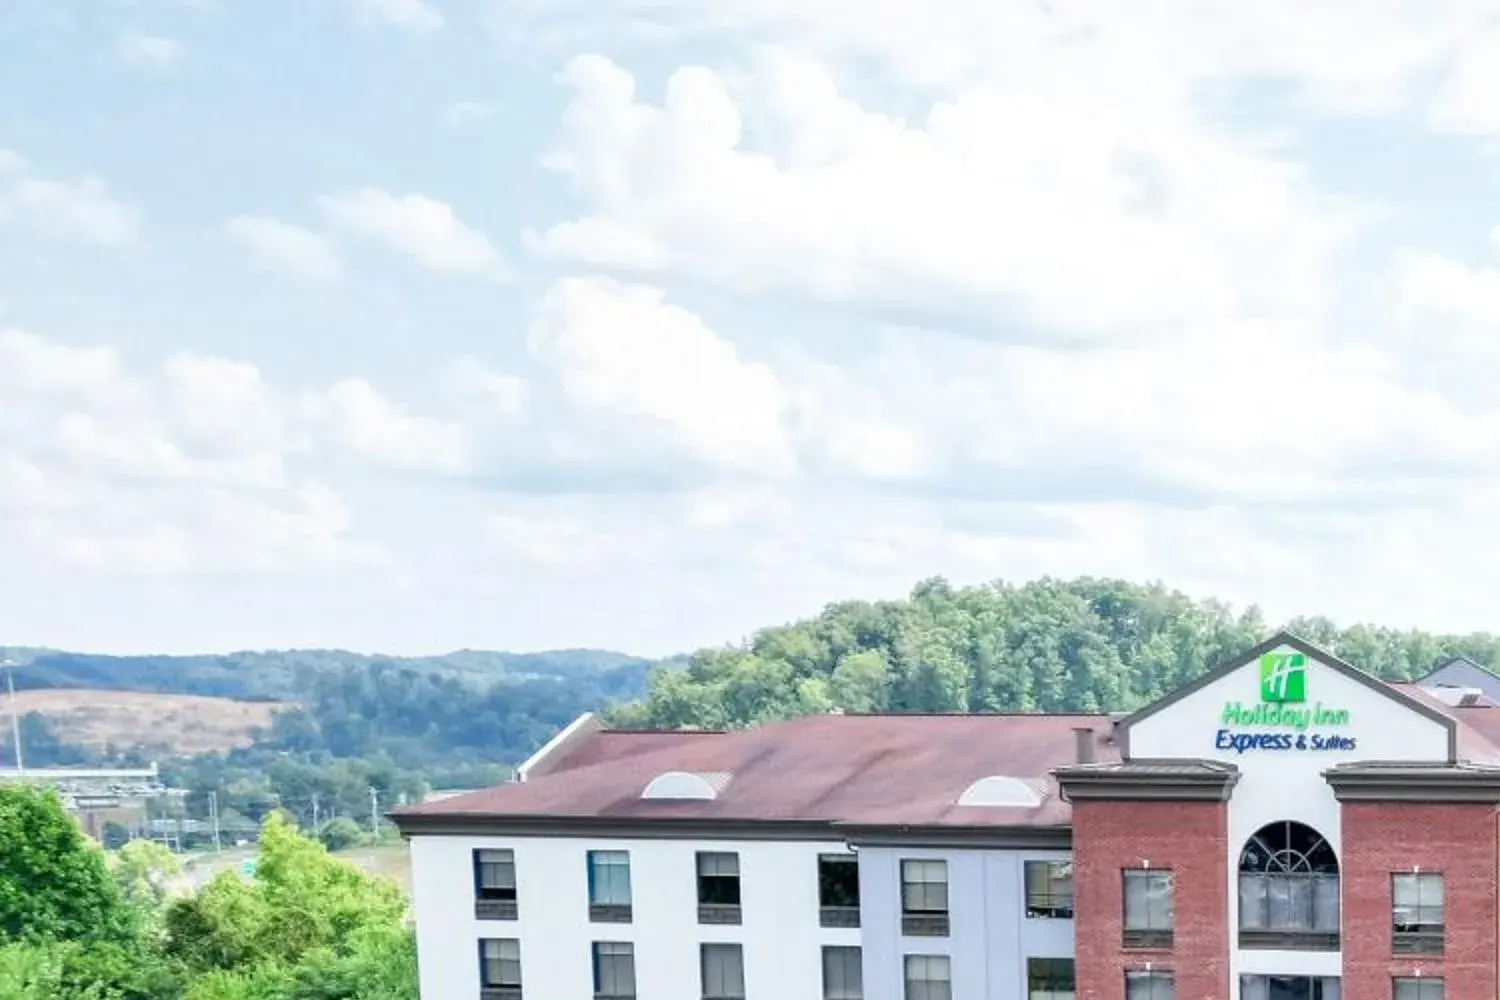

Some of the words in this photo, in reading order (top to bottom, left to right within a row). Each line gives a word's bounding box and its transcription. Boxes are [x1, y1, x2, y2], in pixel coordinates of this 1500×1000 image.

[1222, 702, 1310, 732] Holiday
[1314, 702, 1350, 725] Inn
[1216, 730, 1292, 753] Express
[1296, 735, 1307, 750] &
[1310, 734, 1356, 751] Suites
